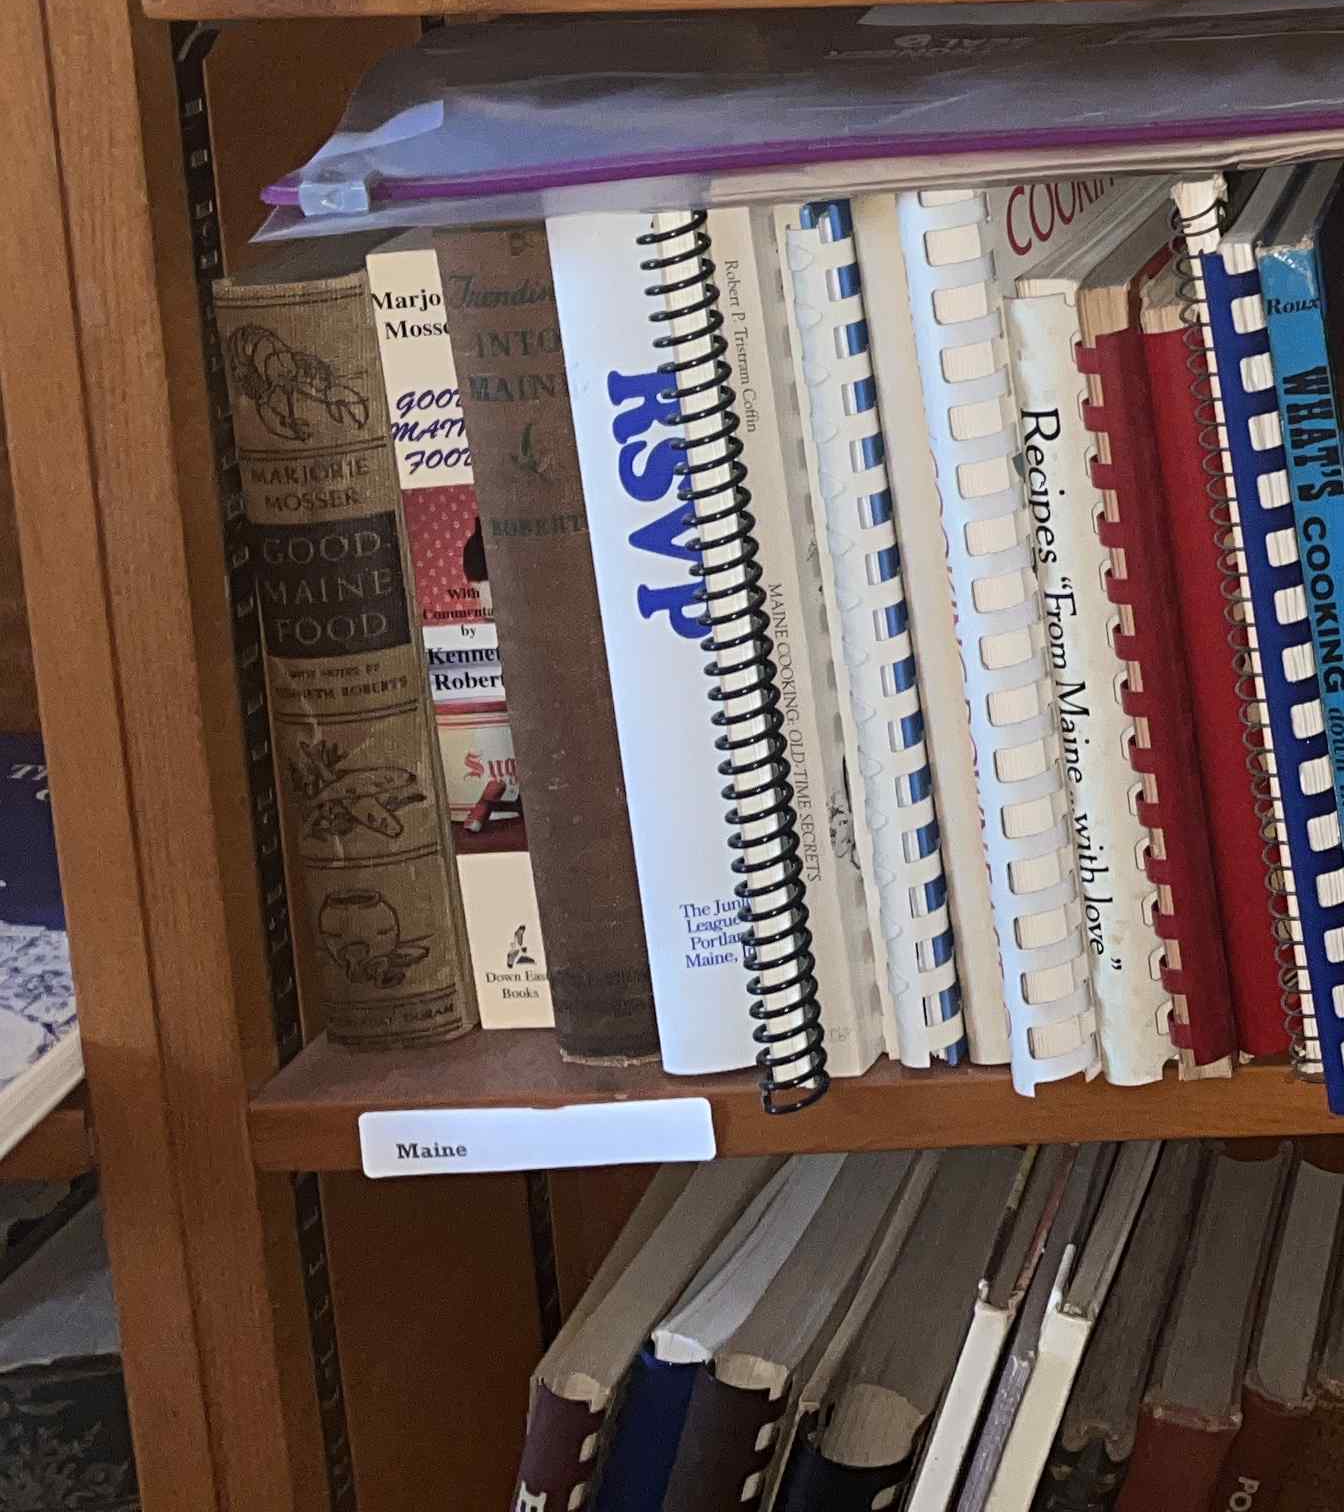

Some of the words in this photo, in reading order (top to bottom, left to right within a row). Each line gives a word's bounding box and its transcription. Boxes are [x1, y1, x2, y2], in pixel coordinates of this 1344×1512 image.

[1282, 364, 1344, 503] WHAT'S
[262, 533, 384, 564] GOOD
[264, 570, 392, 606] MAINE
[274, 611, 390, 643] FOOD
[501, 985, 540, 1000] Books
[396, 1140, 468, 1160] Maine
